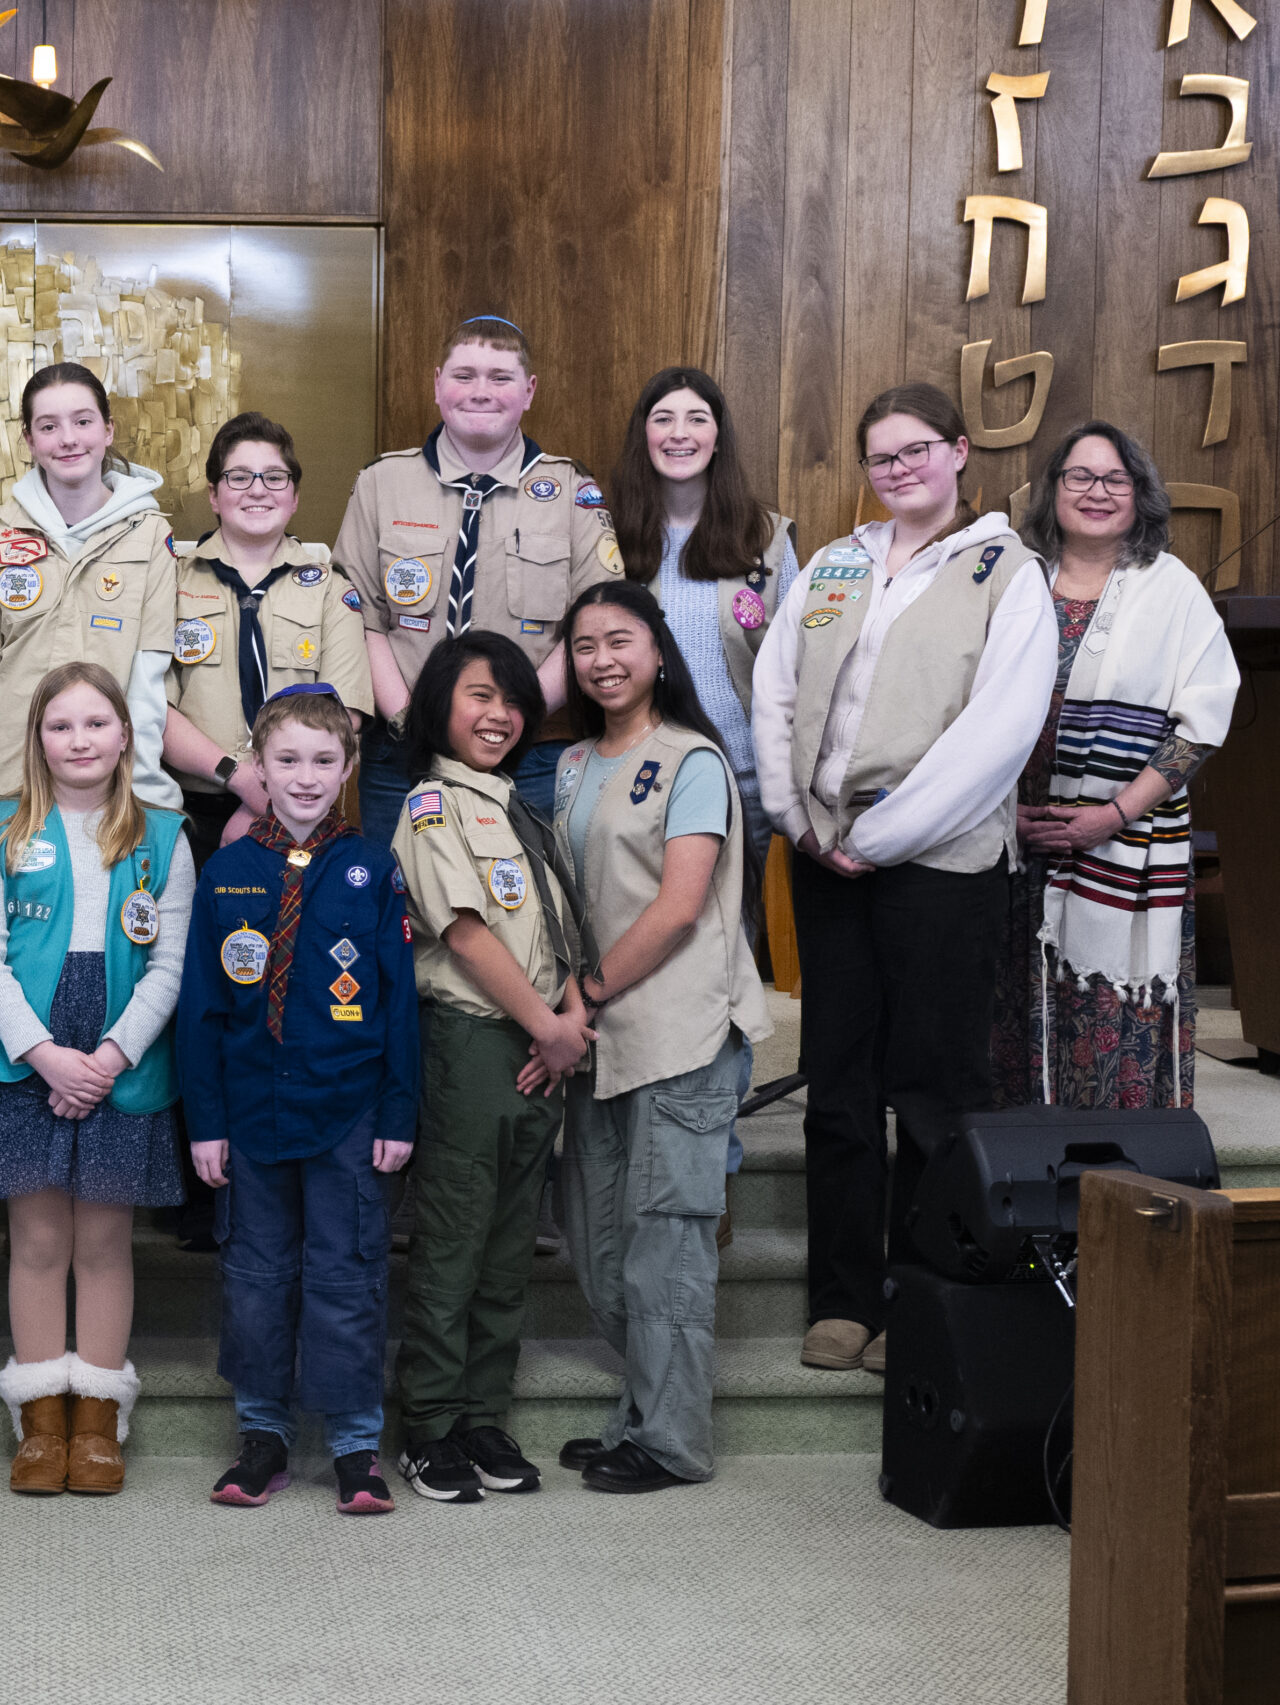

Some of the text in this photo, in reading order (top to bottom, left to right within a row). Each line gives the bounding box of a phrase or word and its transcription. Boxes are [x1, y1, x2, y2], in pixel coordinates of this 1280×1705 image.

[214, 886, 227, 894] CUB
[227, 886, 251, 895] SCOUTS
[7, 900, 52, 921] 6122
[340, 1010, 355, 1018] LION
